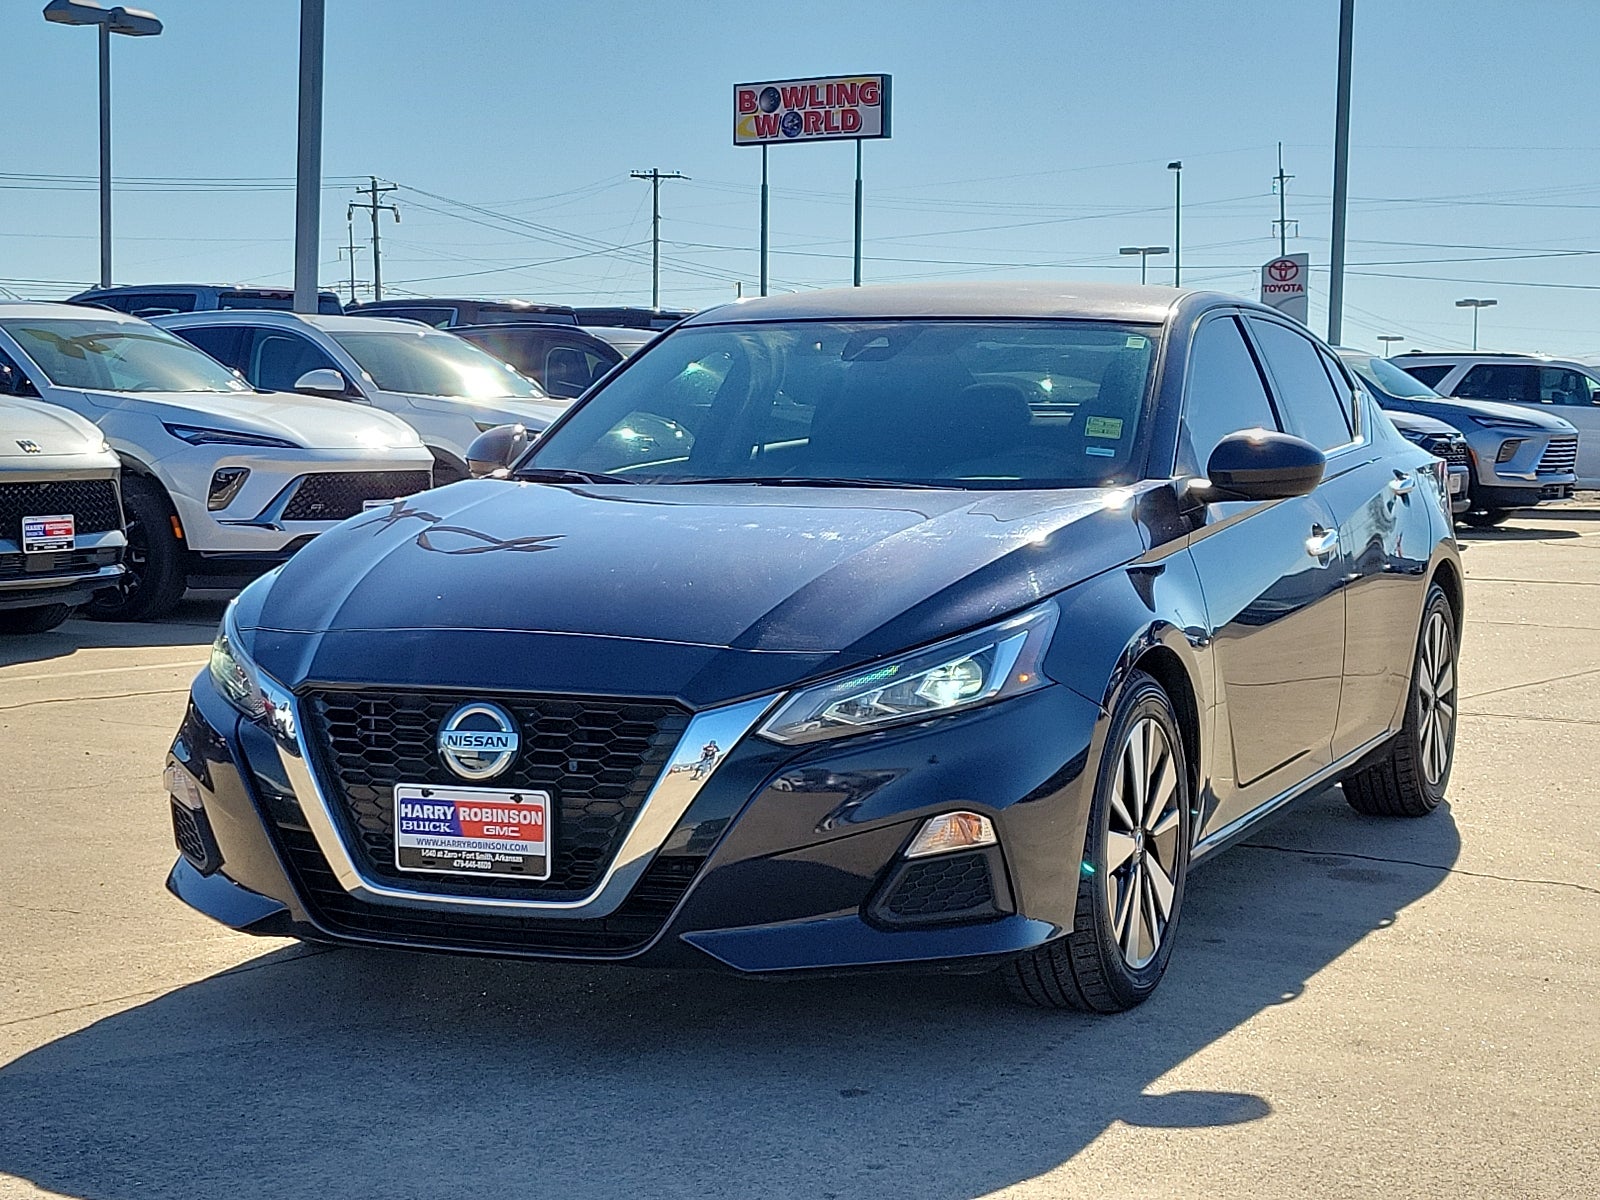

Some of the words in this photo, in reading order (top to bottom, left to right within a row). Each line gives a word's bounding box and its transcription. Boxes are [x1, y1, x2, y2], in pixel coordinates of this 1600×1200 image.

[739, 82, 880, 113] BOWLING
[754, 108, 862, 139] WORLD
[1263, 284, 1304, 293] TOYOTA
[447, 735, 509, 747] NISSAN
[401, 804, 455, 820] HARRY
[459, 807, 543, 825] ROBINSON
[402, 820, 454, 833] BUICK
[483, 825, 521, 836] GMC
[416, 838, 528, 852] WWW.HARRYROBINSON.COM
[462, 852, 475, 860] Fort
